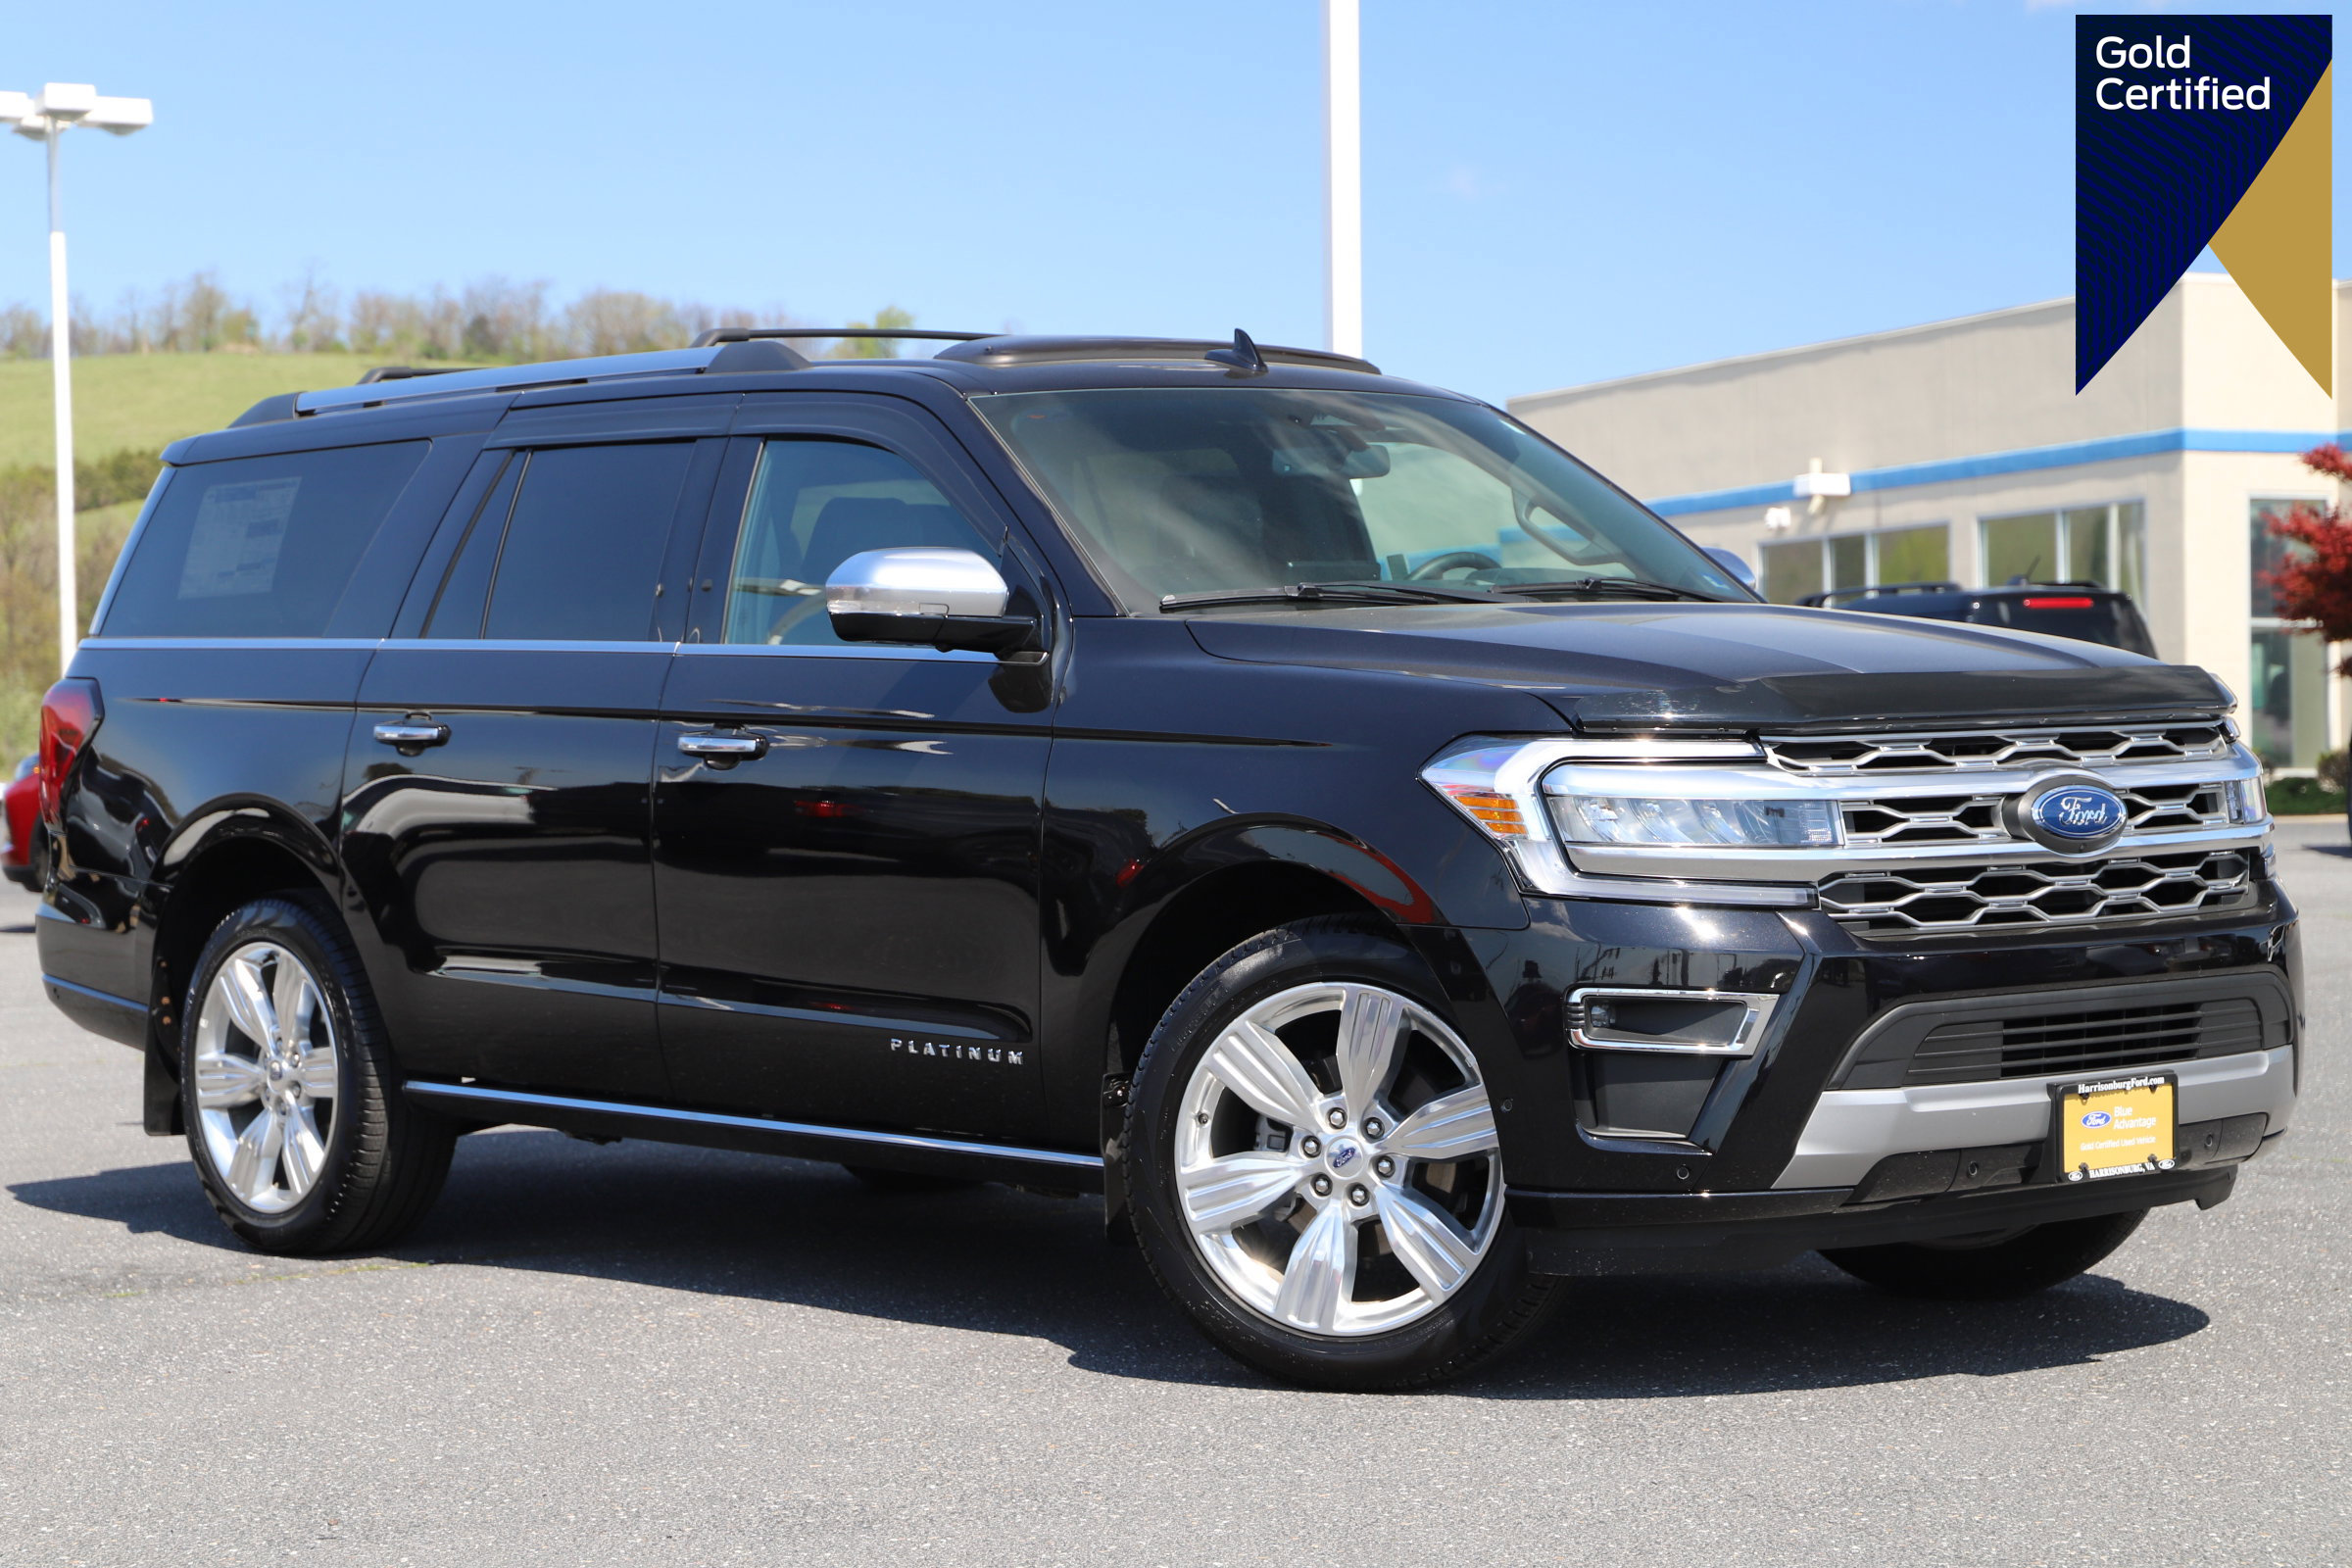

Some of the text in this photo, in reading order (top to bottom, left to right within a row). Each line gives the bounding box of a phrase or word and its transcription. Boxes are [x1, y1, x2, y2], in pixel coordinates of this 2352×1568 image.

[2059, 796, 2108, 826] Ford
[890, 1038, 1024, 1065] PLATINUM
[2078, 1077, 2164, 1094] HarrisonburgFord.com
[2114, 1105, 2132, 1116] Blue
[2114, 1117, 2156, 1129] Advantage
[2089, 1163, 2145, 1178] HARRISONBURG,
[2145, 1162, 2156, 1171] VA
